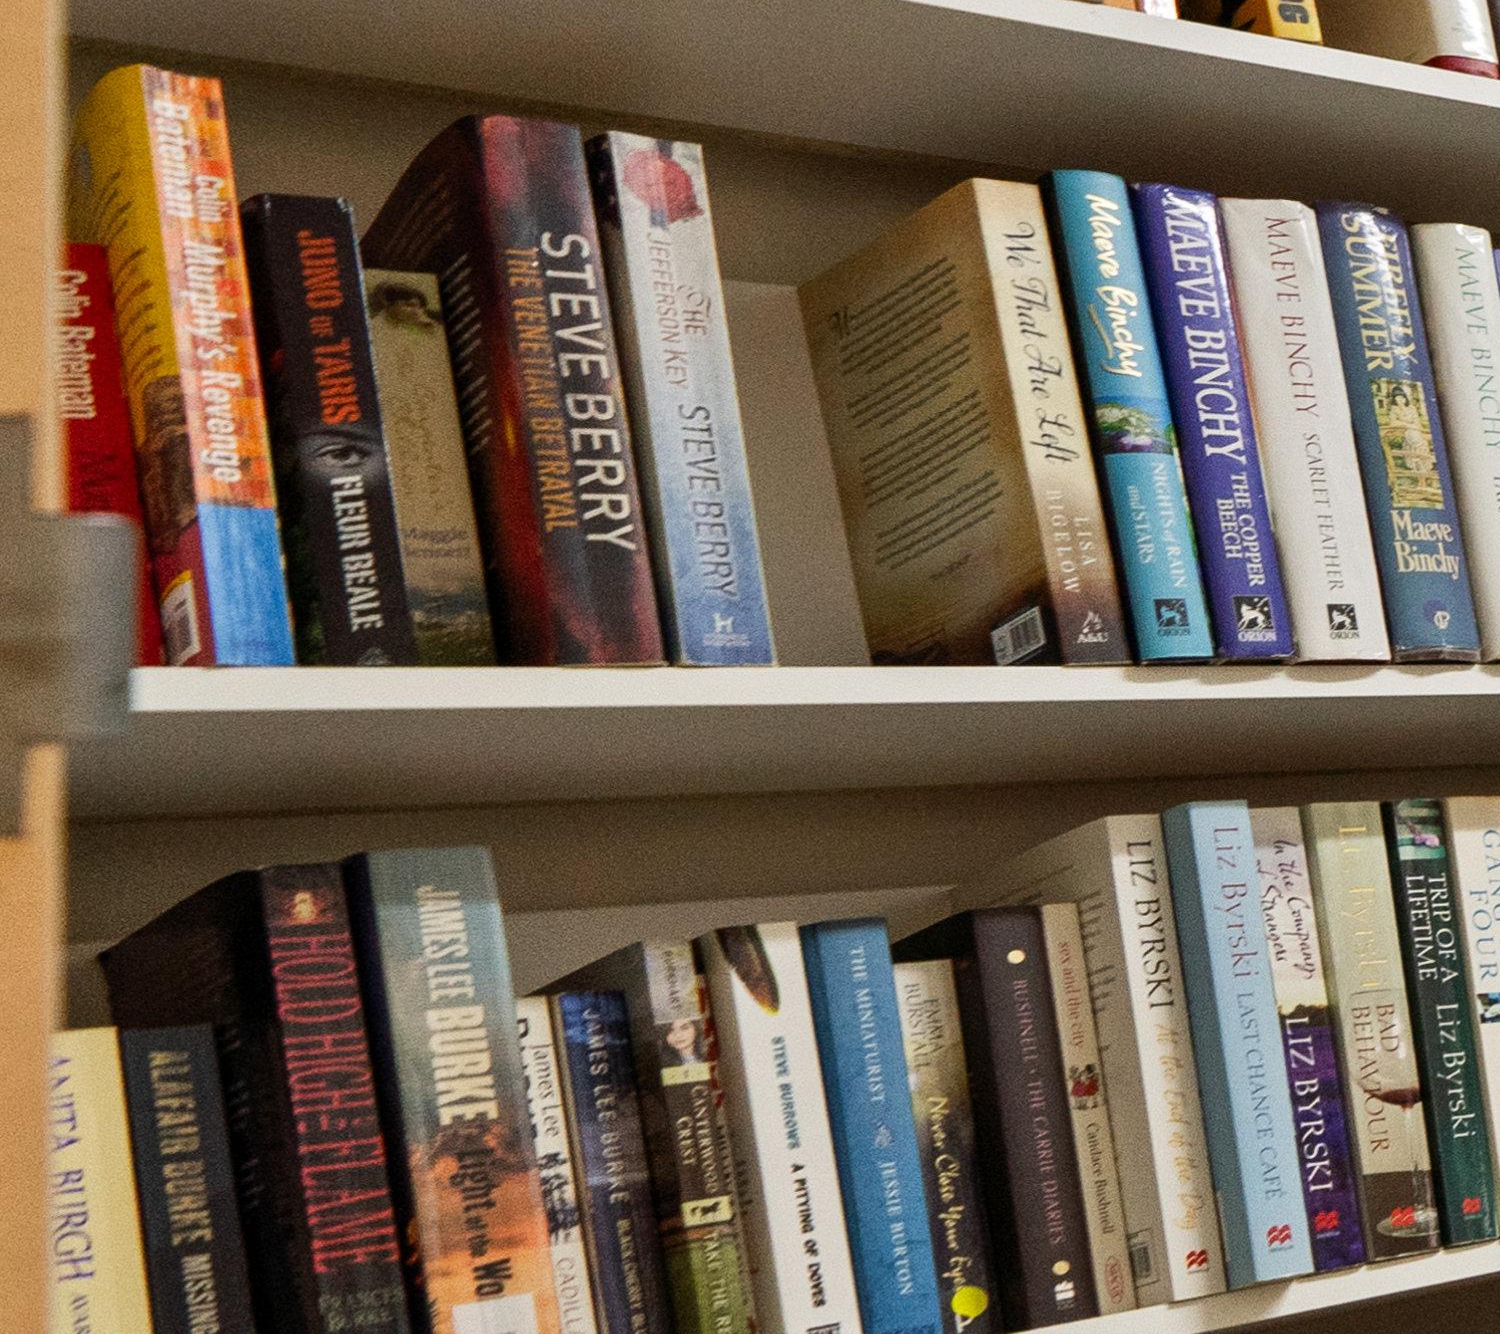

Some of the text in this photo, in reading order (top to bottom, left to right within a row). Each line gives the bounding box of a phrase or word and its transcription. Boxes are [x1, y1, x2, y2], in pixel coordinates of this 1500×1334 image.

[151, 90, 198, 220] Bateman
[181, 174, 244, 485] Colin Murphy's Revenge
[296, 227, 344, 311] JUNO
[643, 229, 691, 391] JEFFERSON KEY
[1000, 219, 1082, 466] We That Are Left
[1085, 191, 1145, 380] Maeve Binchy
[1161, 191, 1249, 469] MAEVE BINCHY
[1337, 211, 1399, 373] SUMMER
[1454, 245, 1492, 338] MAEVE
[317, 340, 362, 427] TARIS
[504, 245, 574, 534] THE VENETIAN BETRAYAL
[539, 229, 639, 554] STEVE BERRY
[1261, 215, 1345, 593] MAEVE BINCHY SCARLET FEATHER
[330, 473, 385, 634] FLEUR BEALE
[676, 403, 740, 602] STEVE BERRY
[1215, 495, 1249, 562] BEECH
[1231, 469, 1267, 590] THE COPPER
[1390, 508, 1456, 546] Maeve
[1396, 535, 1462, 583] Binchy
[1126, 839, 1176, 1012] LIZ BYRSKI
[1211, 825, 1261, 977] Liz Byrski
[1403, 874, 1439, 983] LIFETIME
[416, 884, 503, 1131] JAMES LEE BURKE
[1283, 1015, 1336, 1196] LIZ BYRSKI
